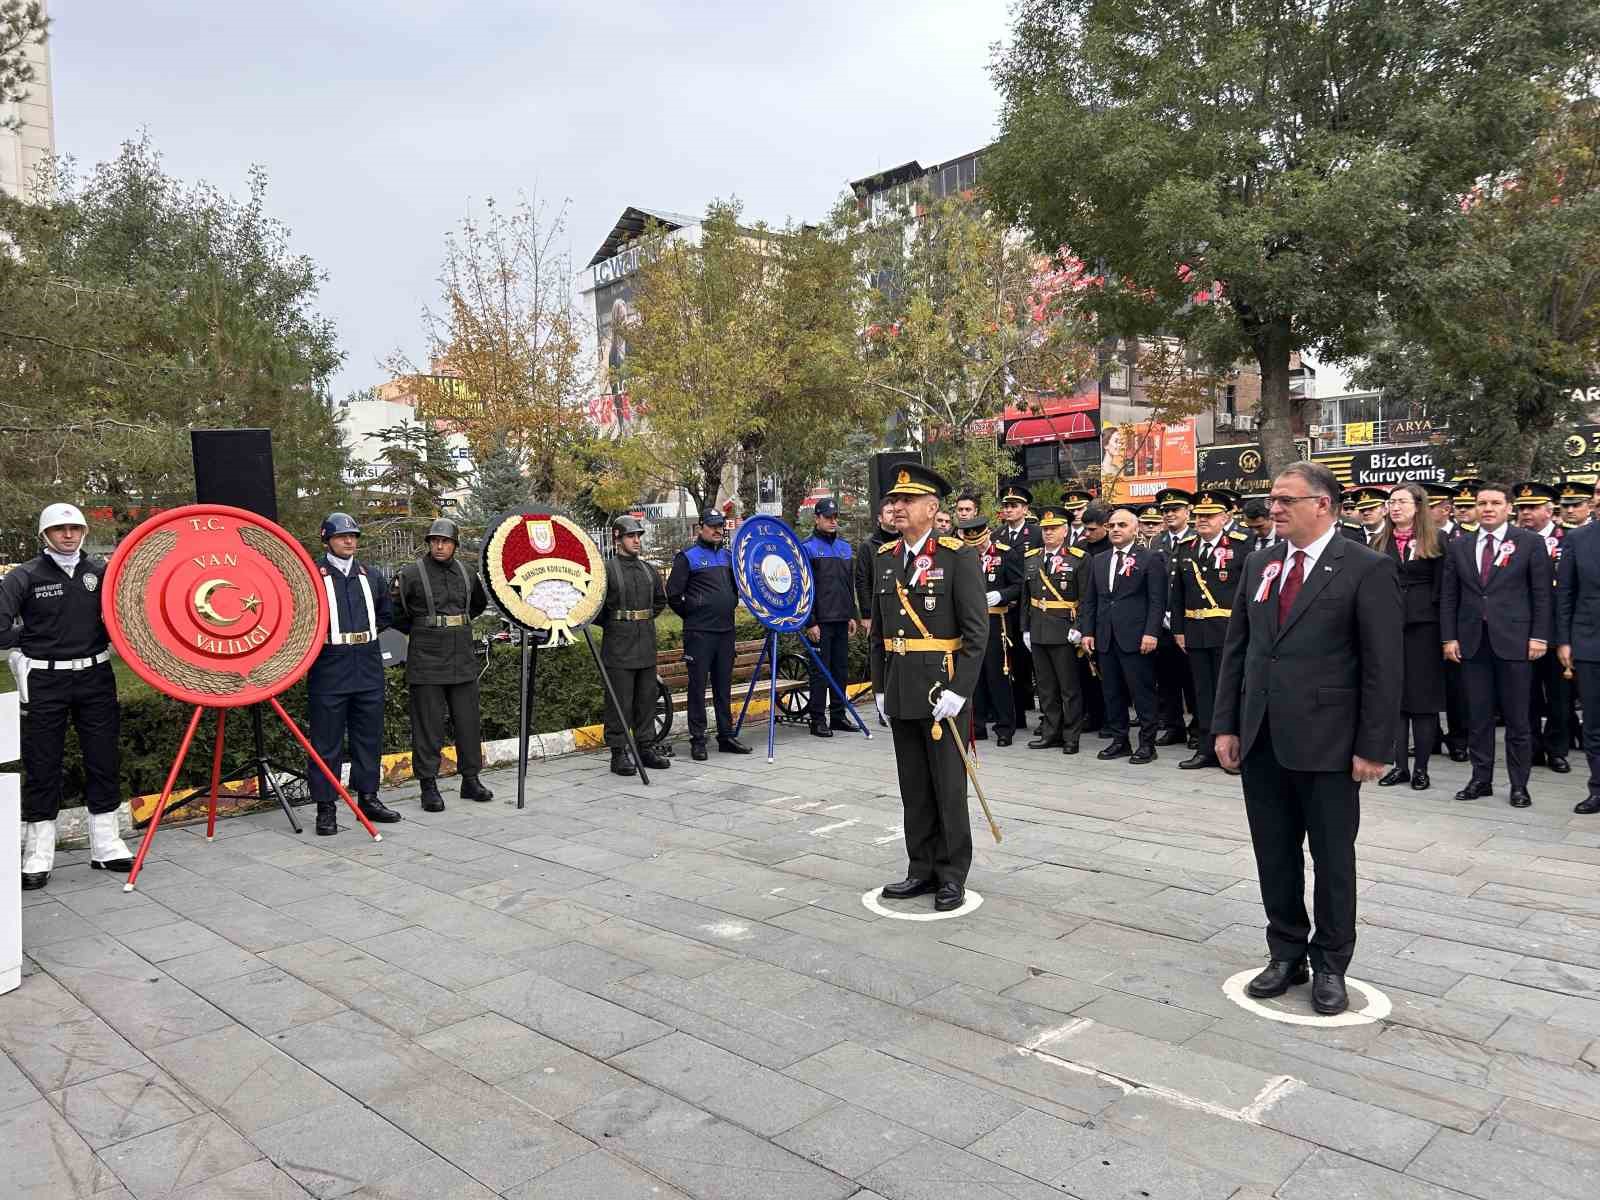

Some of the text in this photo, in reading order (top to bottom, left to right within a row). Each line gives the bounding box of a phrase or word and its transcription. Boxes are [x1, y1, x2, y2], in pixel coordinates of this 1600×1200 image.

[1393, 420, 1432, 432] ARYA
[1359, 466, 1446, 484] Kuruyemiş
[189, 518, 225, 531] T.C.
[192, 552, 238, 569] VAN
